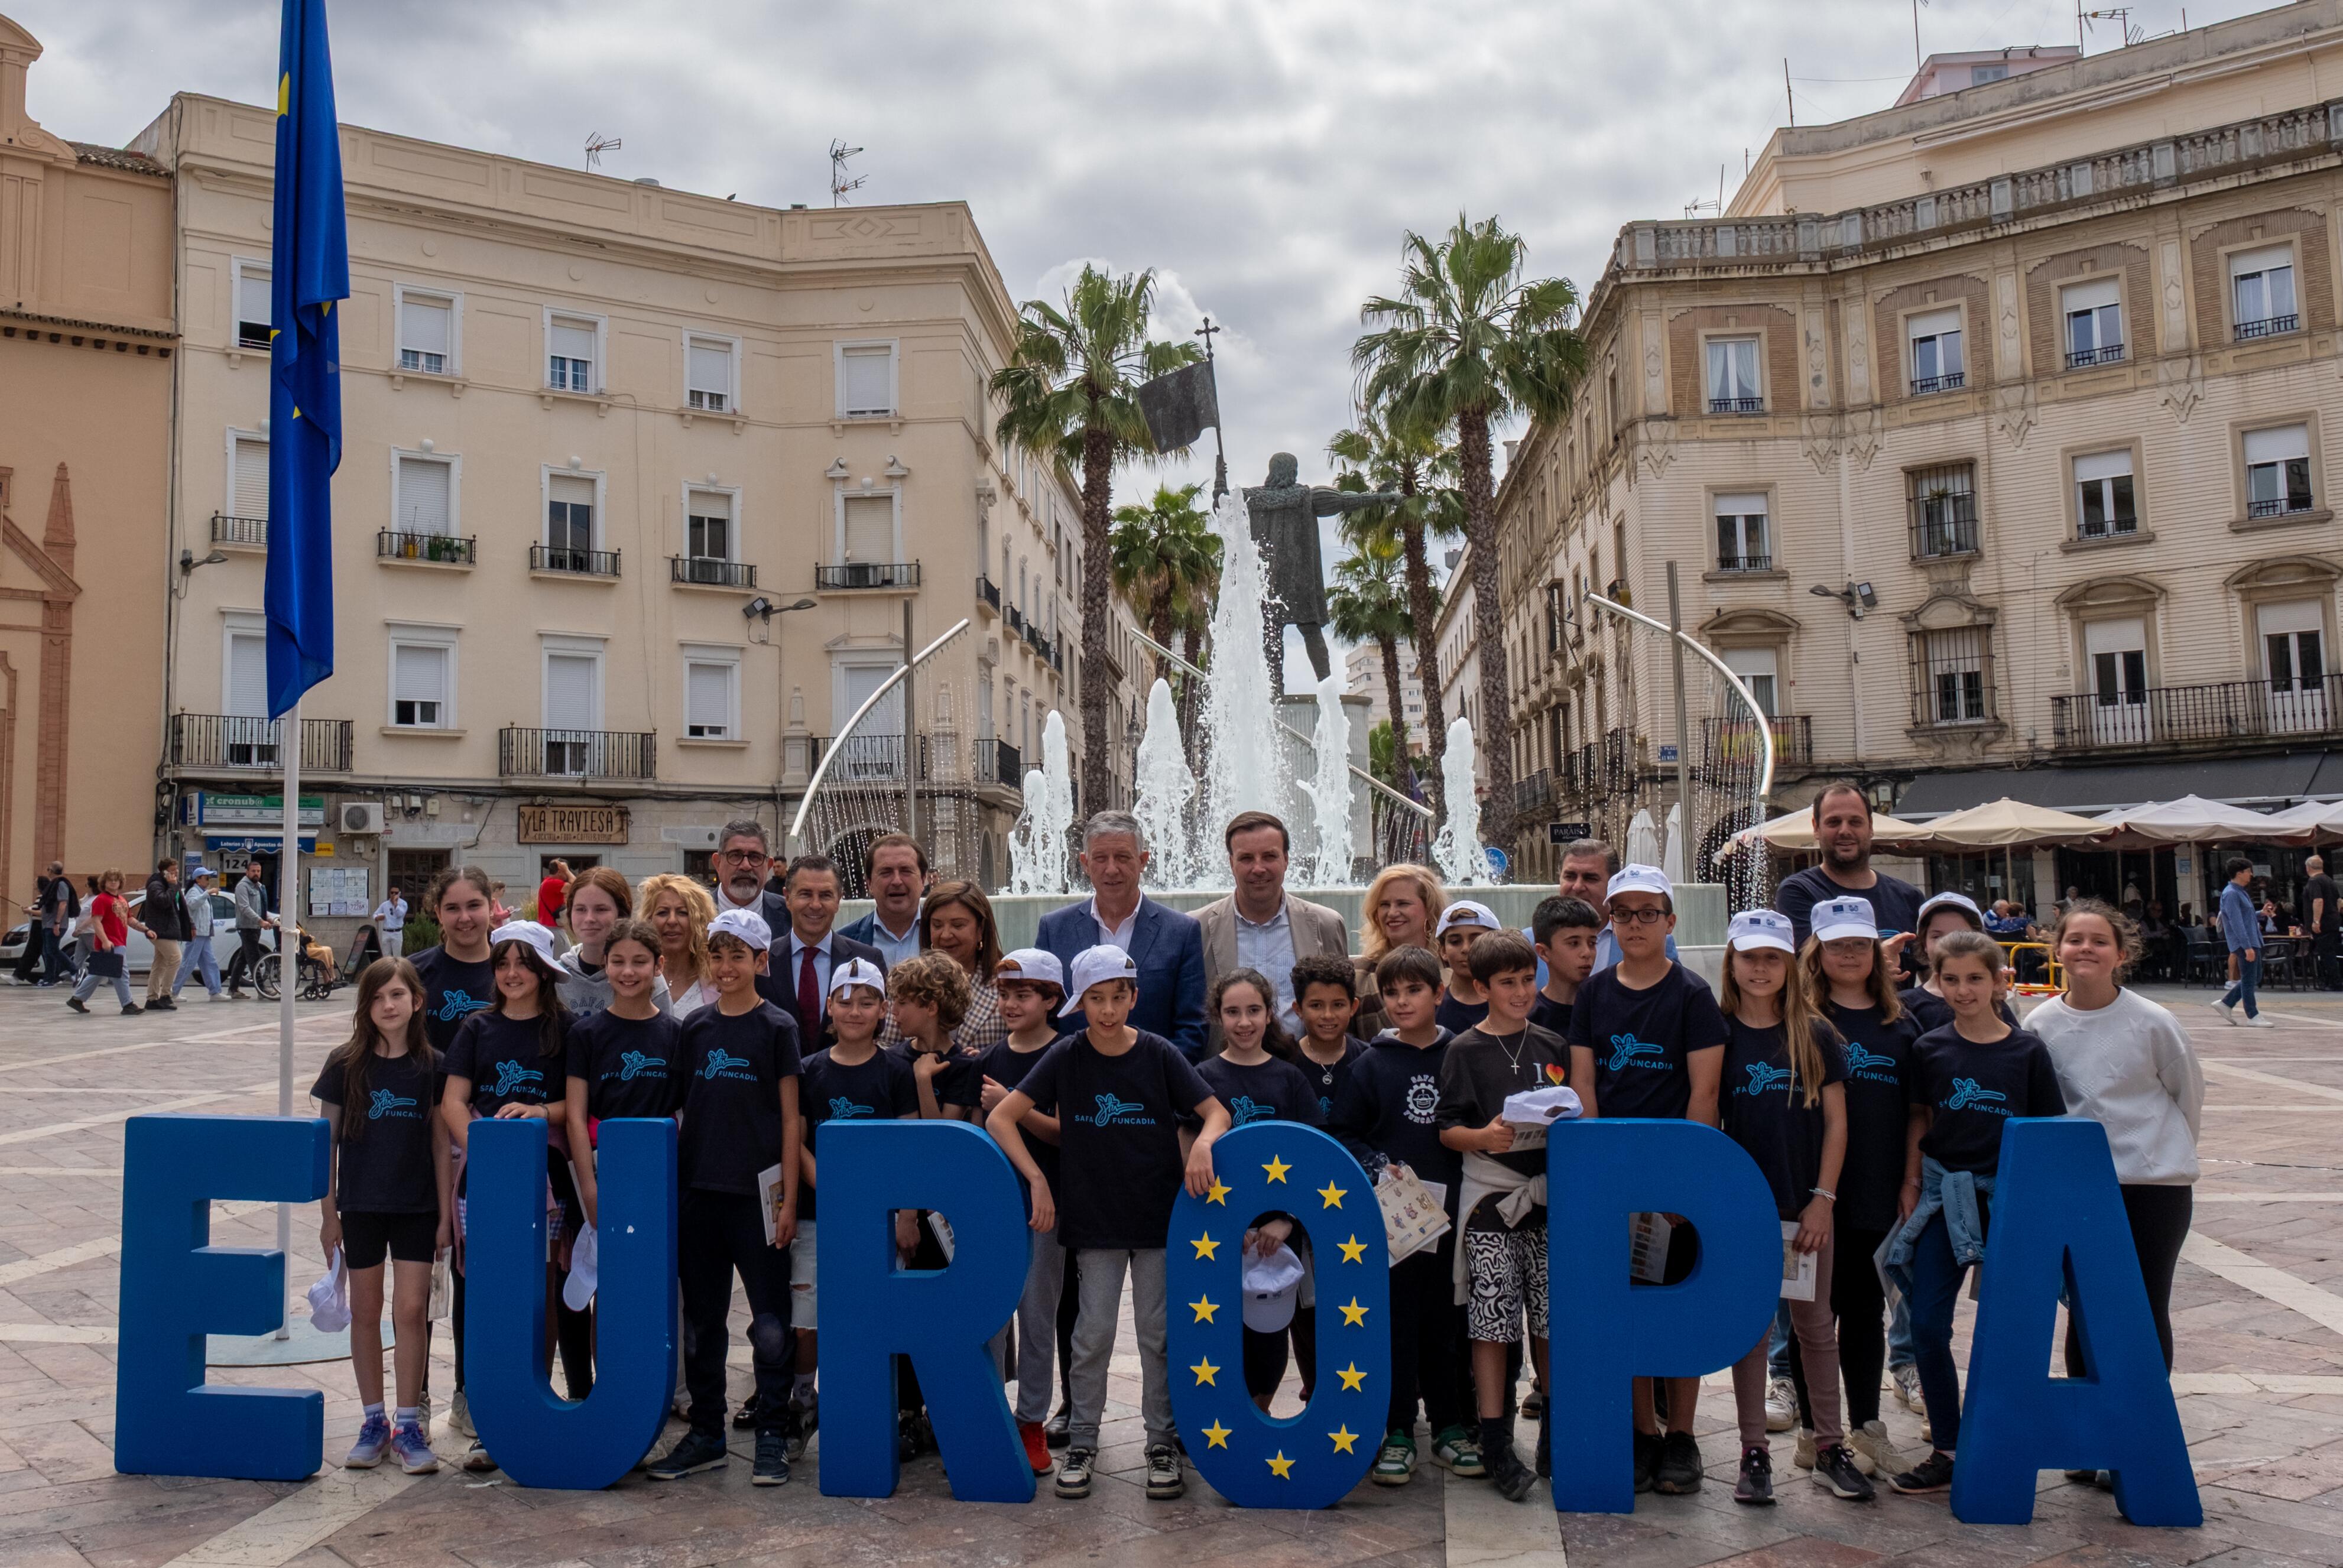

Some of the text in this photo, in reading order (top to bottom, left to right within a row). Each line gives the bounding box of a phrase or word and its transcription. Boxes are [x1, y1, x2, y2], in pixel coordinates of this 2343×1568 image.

[533, 810, 613, 832] LA TRAVIESA
[570, 996, 605, 1010] SAFA
[1074, 1115, 1156, 1125] SAFA FUNCADIA
[115, 1114, 2205, 1527] EUROPA
